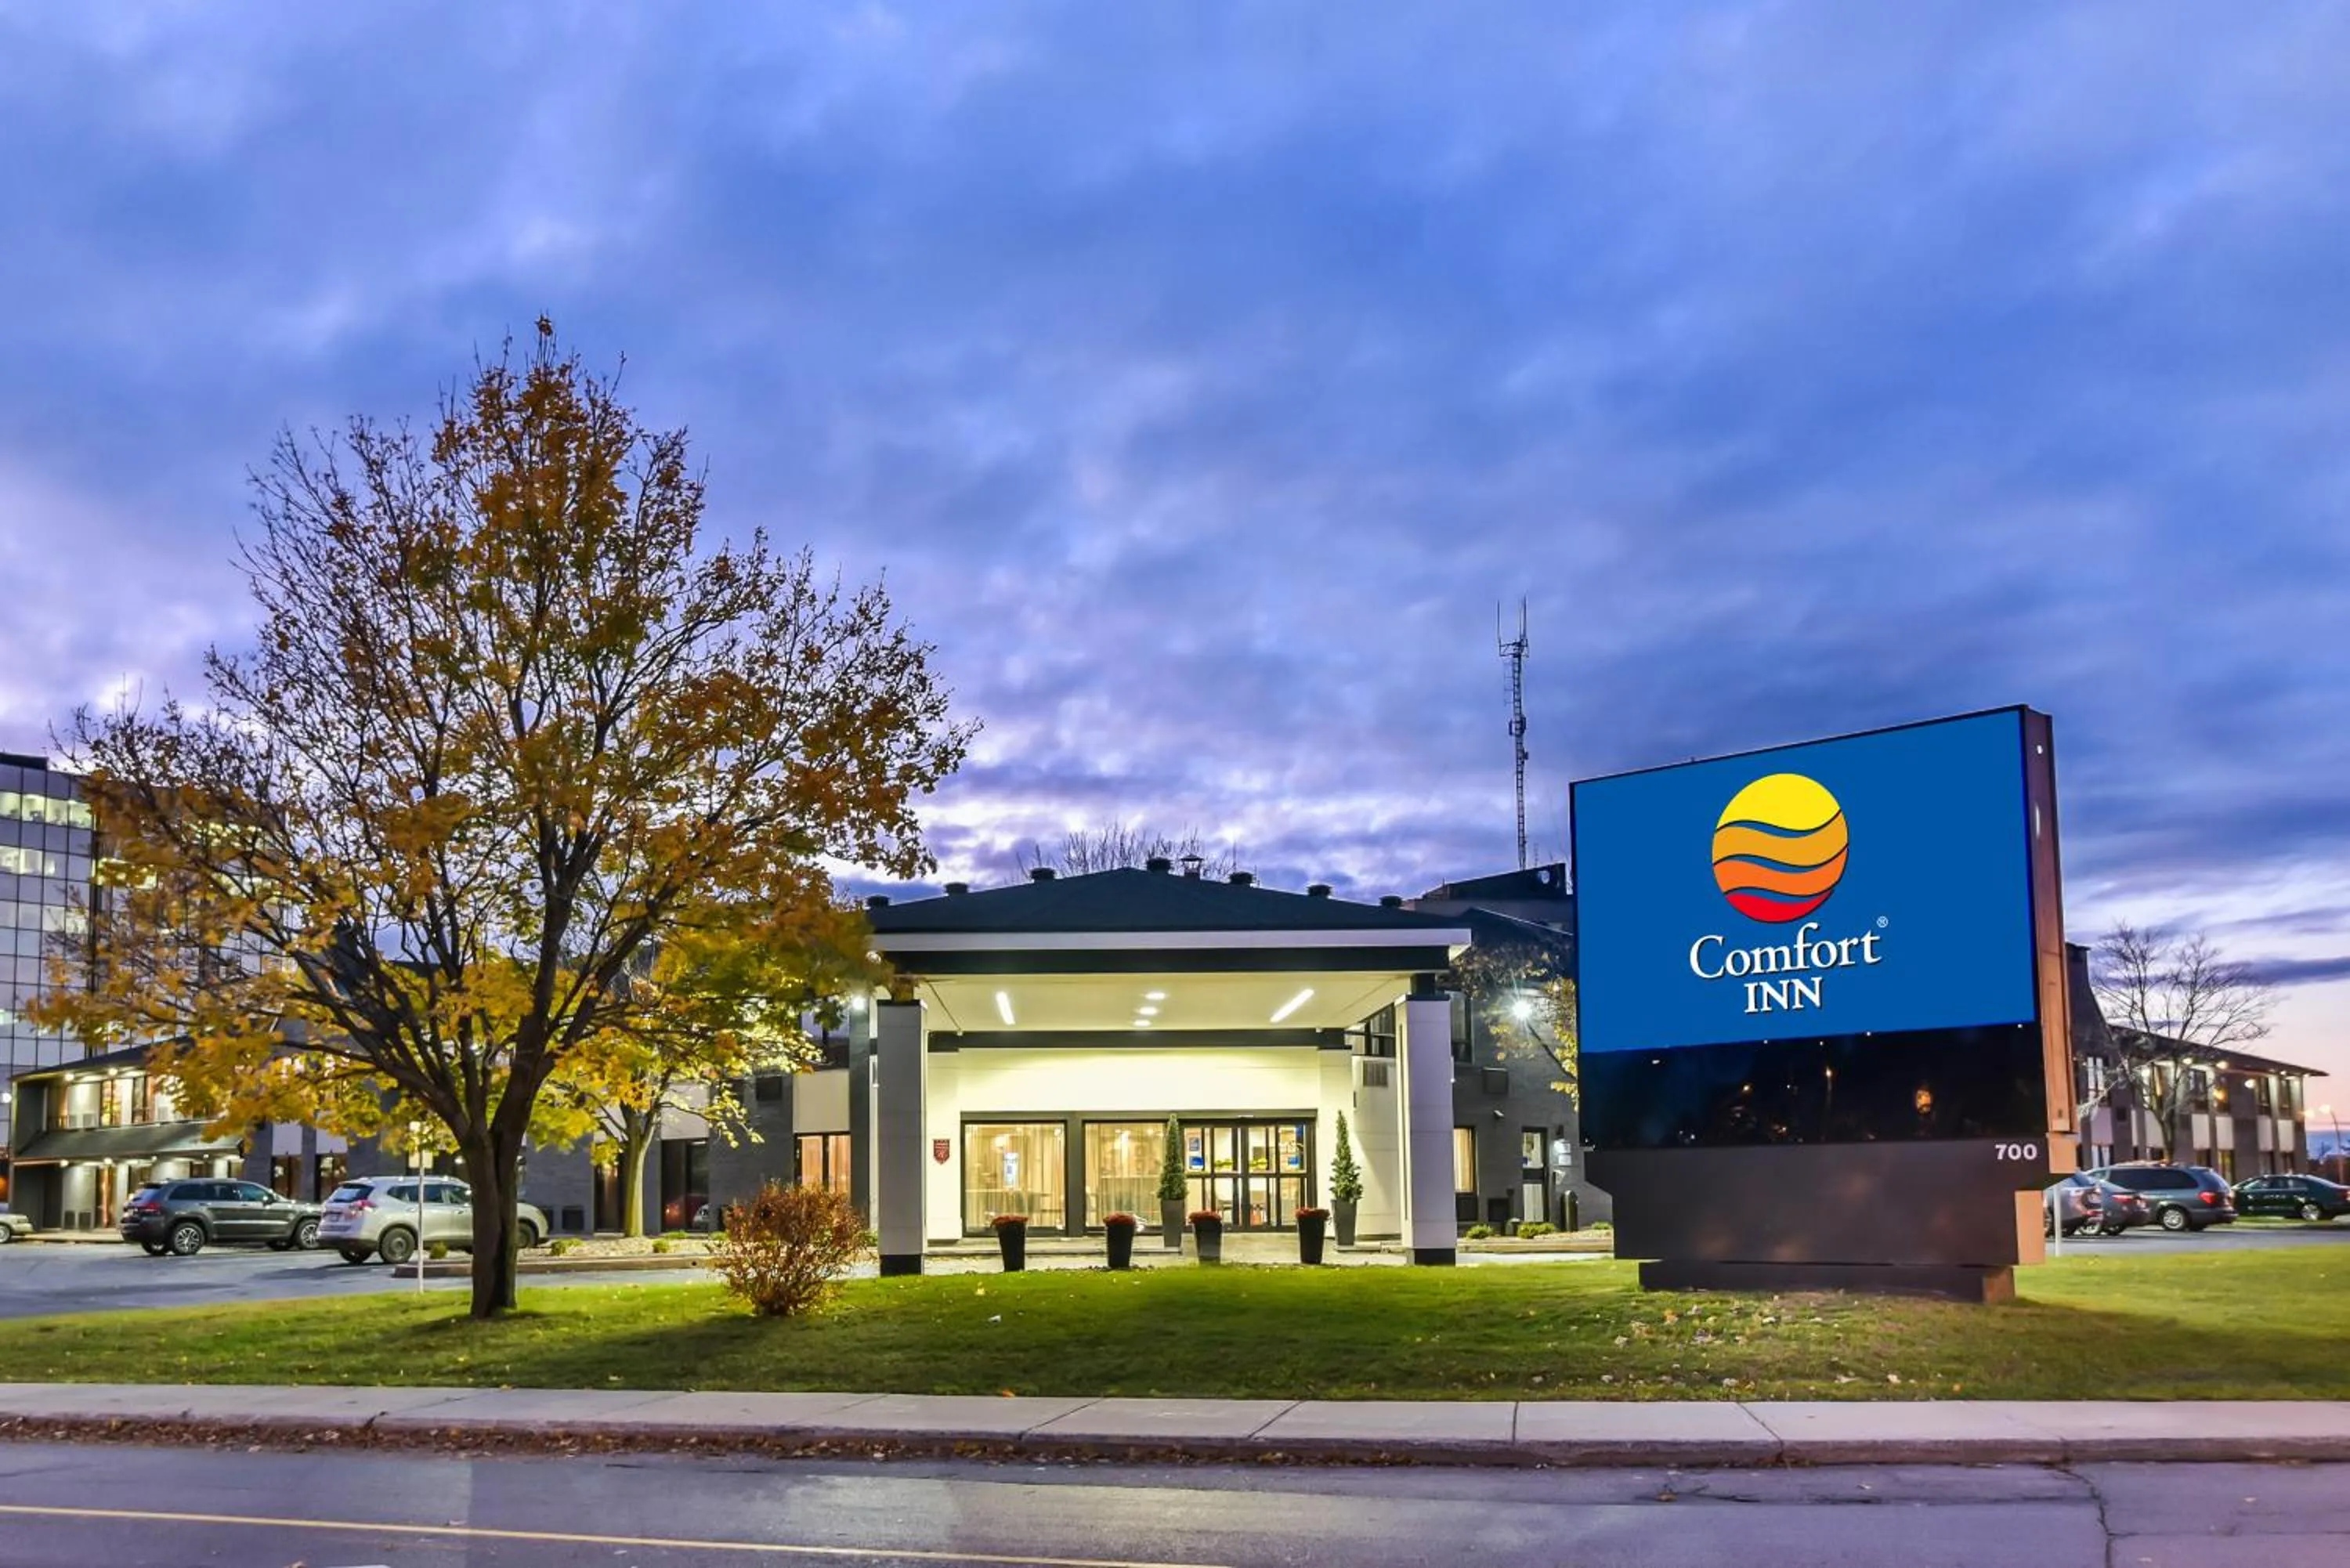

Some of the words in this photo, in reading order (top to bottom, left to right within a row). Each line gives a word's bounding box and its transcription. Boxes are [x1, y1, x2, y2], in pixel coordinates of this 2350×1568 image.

[1689, 922, 1882, 978] Comfort
[1744, 977, 1824, 1013] INN
[1994, 1143, 2038, 1161] 700
